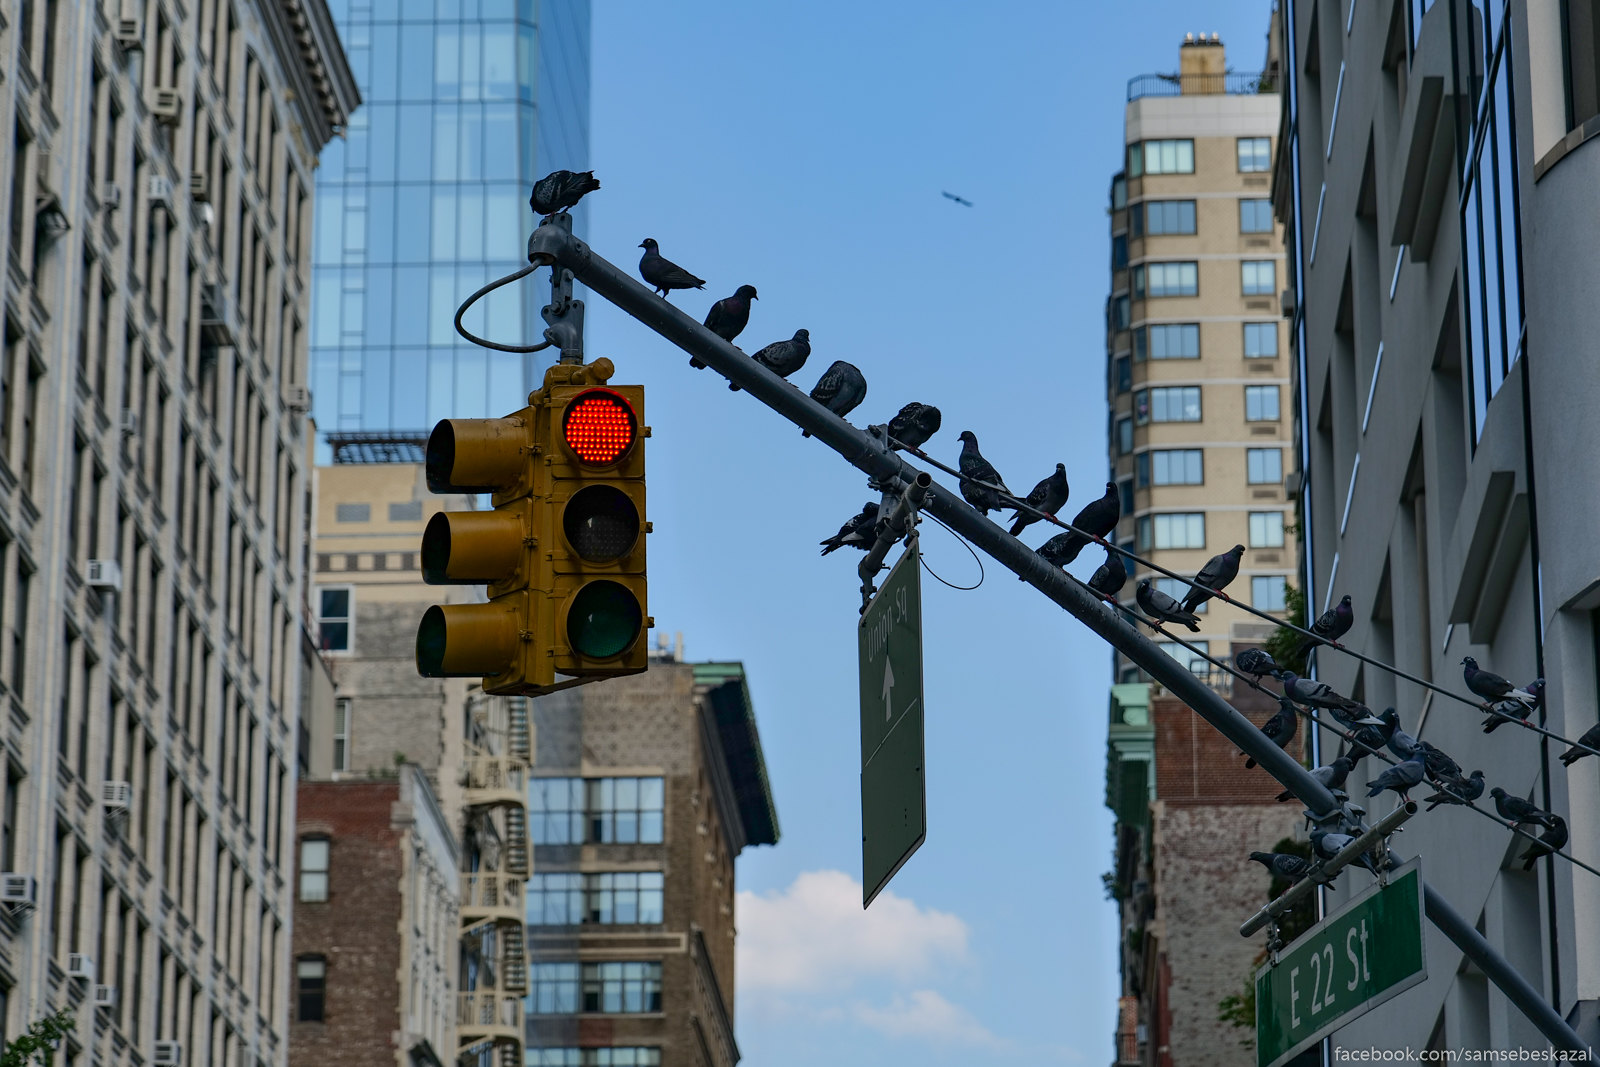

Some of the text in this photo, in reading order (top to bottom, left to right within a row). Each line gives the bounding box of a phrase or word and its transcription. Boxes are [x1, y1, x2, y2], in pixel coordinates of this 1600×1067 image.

[868, 585, 908, 663] Union Sq
[1290, 918, 1371, 1029] E 22 St
